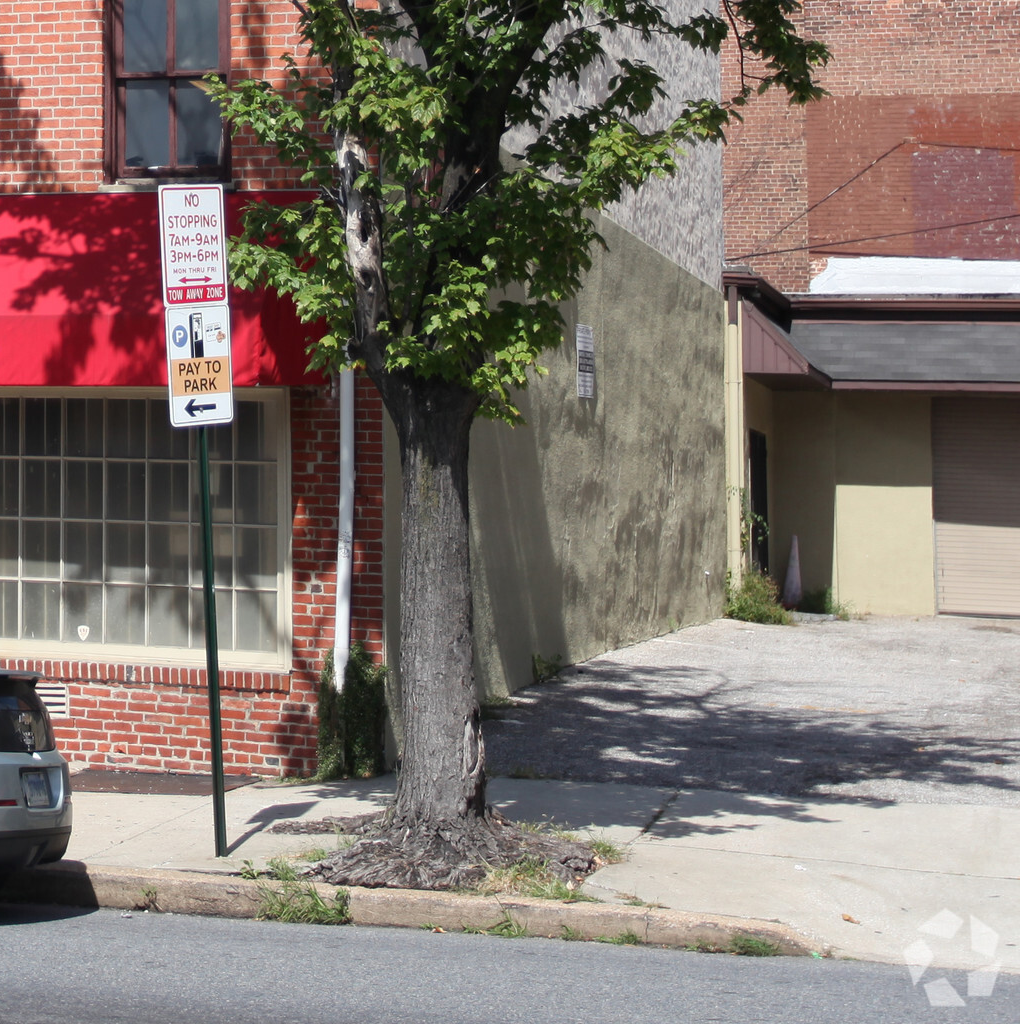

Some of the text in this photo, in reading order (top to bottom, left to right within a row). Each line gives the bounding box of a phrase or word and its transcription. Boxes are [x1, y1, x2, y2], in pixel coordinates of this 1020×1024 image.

[184, 194, 199, 207] NO
[168, 214, 218, 229] STOPPING
[168, 233, 219, 247] 7AM-9AM
[170, 249, 219, 263] 3PM-6PM
[168, 286, 223, 301] TOW AWAY ZONE
[178, 359, 222, 377] PAY TO
[183, 377, 218, 393] PARK
